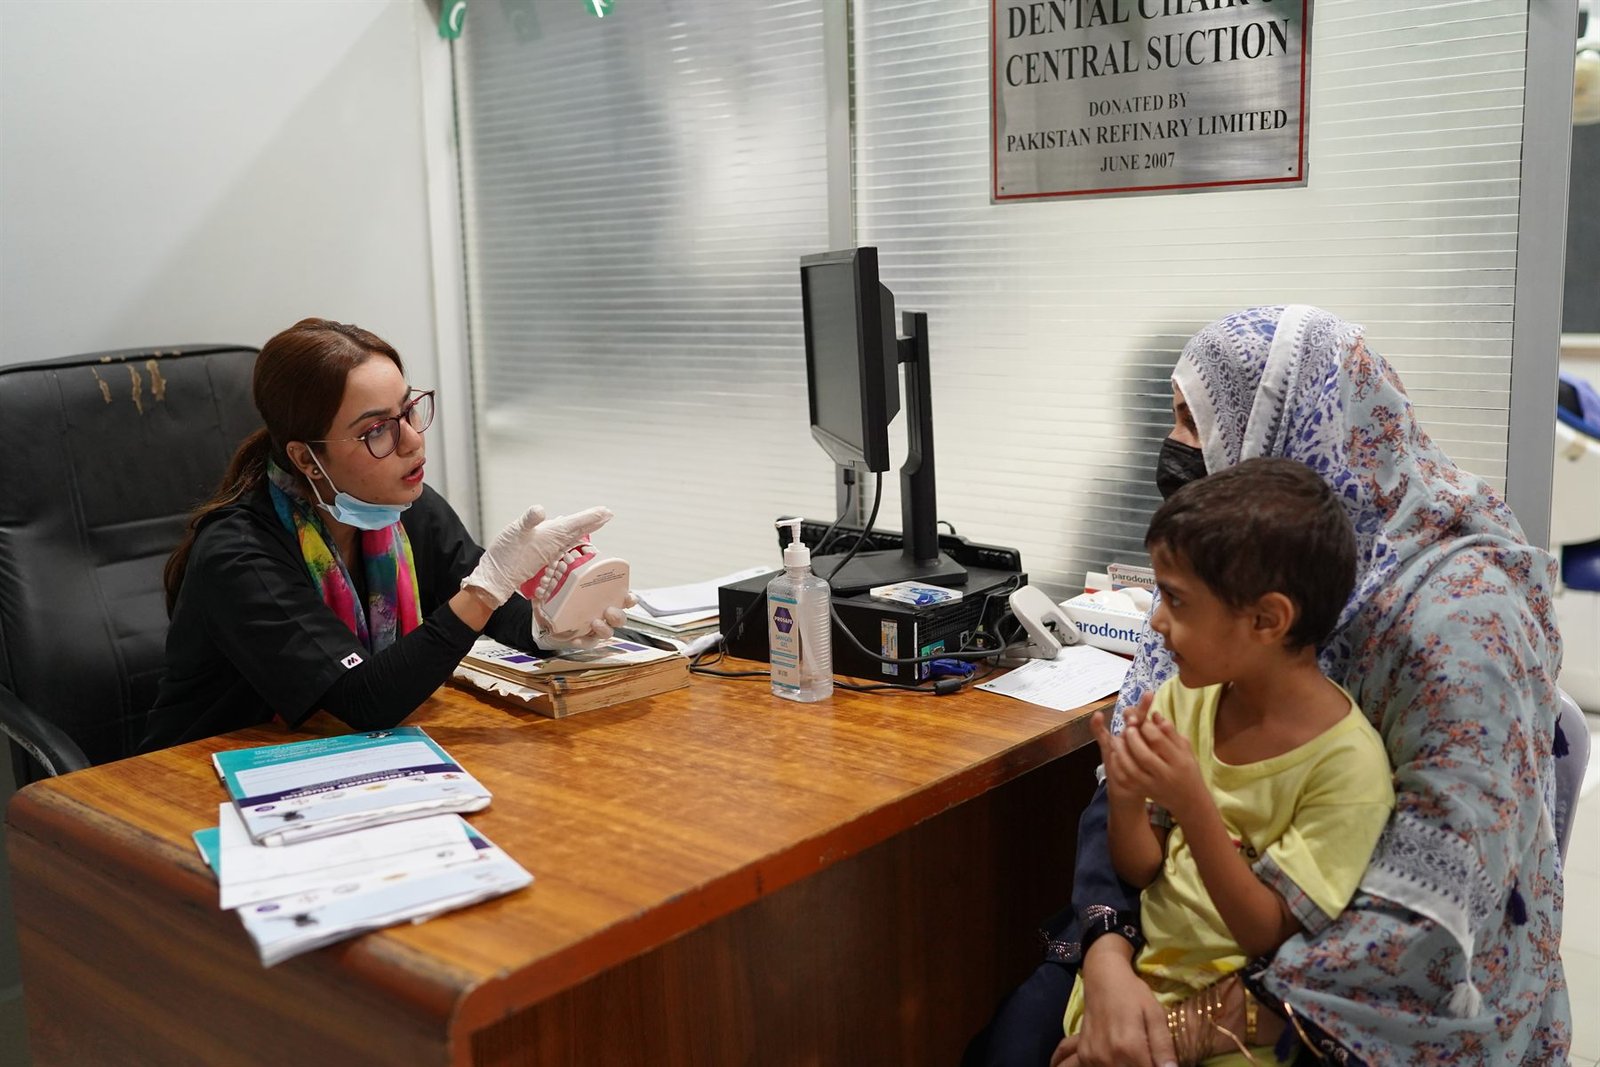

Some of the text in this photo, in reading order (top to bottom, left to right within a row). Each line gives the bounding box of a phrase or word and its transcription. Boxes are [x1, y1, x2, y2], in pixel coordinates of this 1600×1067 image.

[1008, 0, 1130, 39] DENTAL
[1006, 18, 1290, 87] CENTRAL SUCTION
[1089, 92, 1190, 117] DONATED BY
[1007, 109, 1288, 152] PAKISTAN REFINARY LIMITED
[1100, 151, 1175, 173] JUNE 2007
[1112, 573, 1155, 585] parodonta
[1075, 621, 1142, 644] arodonta
